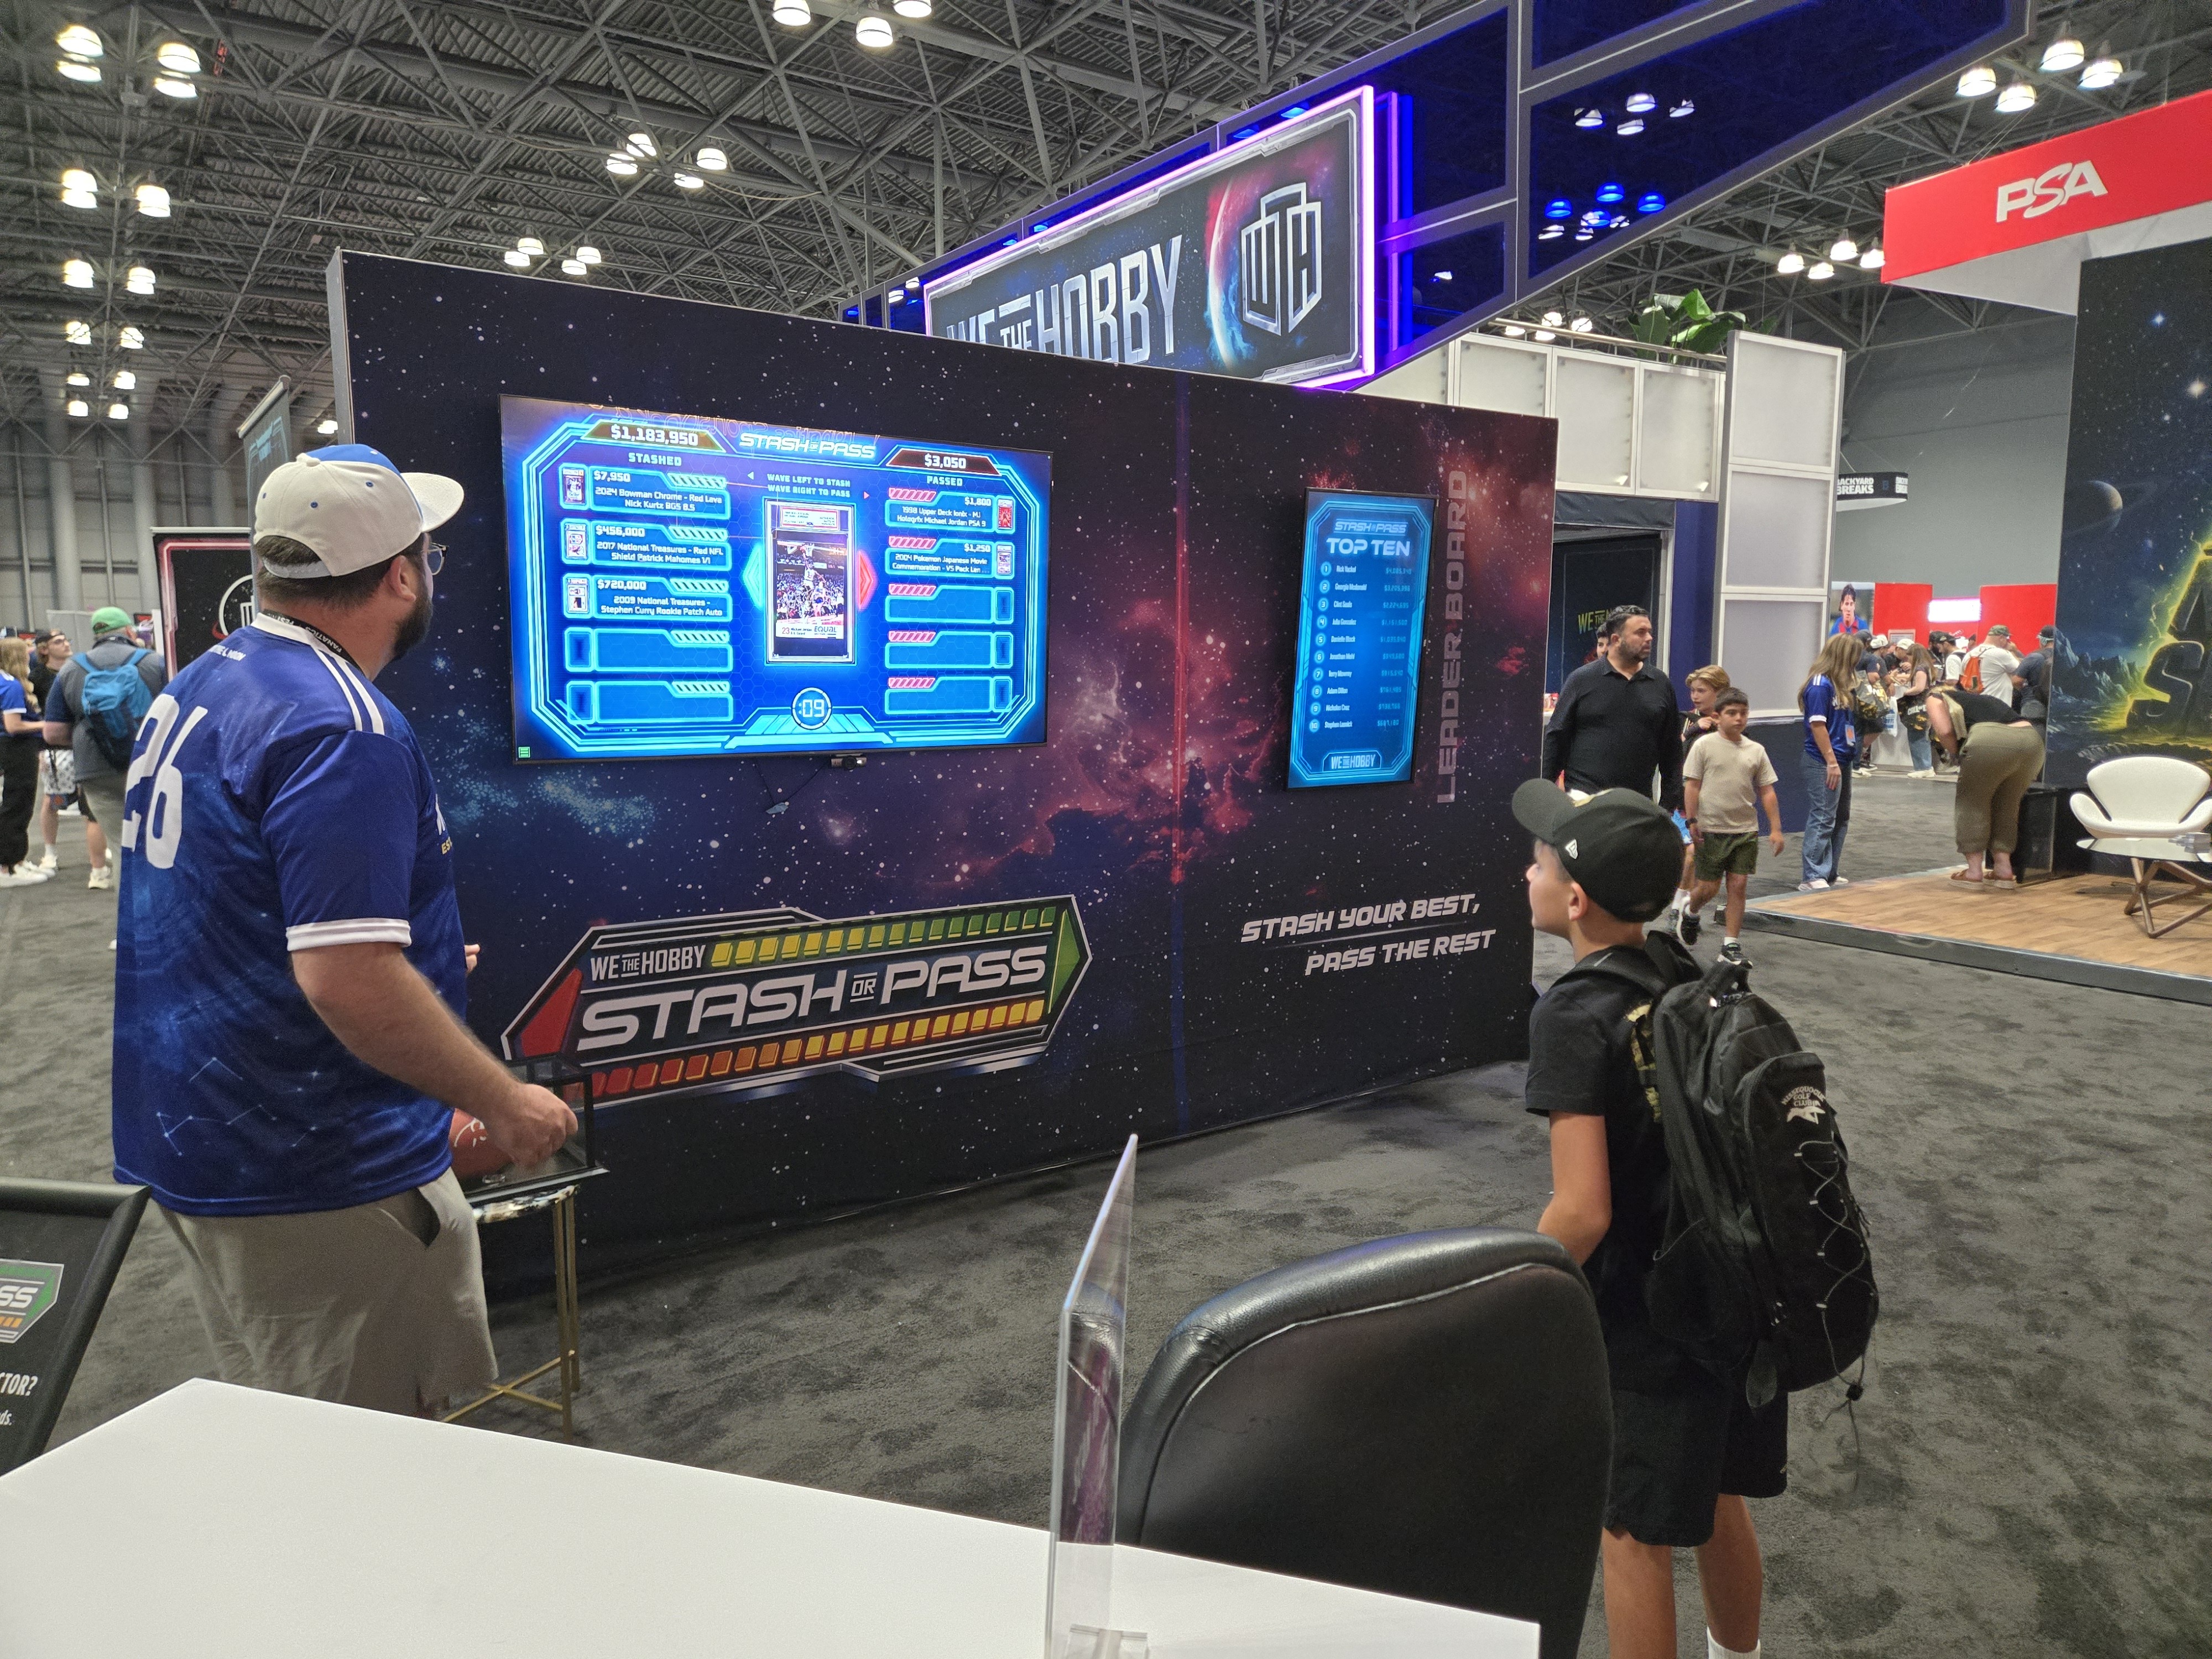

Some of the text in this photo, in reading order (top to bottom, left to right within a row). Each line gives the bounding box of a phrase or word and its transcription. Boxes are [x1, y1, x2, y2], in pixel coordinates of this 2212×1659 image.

[1996, 160, 2108, 222] PSA
[1036, 235, 1182, 364] HOBBY
[611, 424, 698, 446] $1,183,950
[739, 432, 810, 452] STASH
[819, 441, 876, 458] PASS
[628, 453, 682, 466] STASHED
[925, 454, 967, 471] $3,050
[594, 470, 630, 482] $7,950
[767, 473, 790, 482] WAVE
[792, 476, 812, 484] LEFT
[826, 479, 851, 487] STASH
[927, 476, 963, 487] PASSED
[595, 487, 617, 496] 2024
[619, 488, 653, 498] Bowman
[654, 492, 682, 500] Chrome
[706, 495, 722, 504] Lava
[768, 484, 791, 493] WAVE
[792, 487, 816, 495] RIGHT
[1837, 485, 1874, 495] BREAKS
[625, 499, 642, 508] Nick
[644, 500, 664, 509] Kurtz
[666, 502, 681, 510] BGS
[964, 497, 992, 507] $1,800
[919, 507, 936, 516] Upper
[924, 516, 947, 525] Michael
[1335, 521, 1371, 531] STASH
[1376, 524, 1407, 533] PASS
[596, 525, 645, 538] $456,000
[617, 543, 649, 552] National
[651, 544, 686, 553] Treasures
[964, 542, 990, 552] $1,250
[1326, 538, 1410, 556] TOP TEN
[612, 552, 635, 561] Shield
[638, 554, 664, 562] Patrick
[665, 555, 700, 564] Mahomes
[942, 556, 969, 565] Japanese
[893, 562, 941, 571] Commemoration
[597, 579, 646, 591] $720,000
[613, 596, 635, 604] 2009
[637, 597, 669, 606] National
[670, 598, 705, 606] Treasures
[601, 606, 633, 615] Stephen
[634, 607, 654, 615] Curry
[656, 607, 681, 615] Rookie
[683, 607, 703, 615] Patch
[1578, 612, 1594, 634] WE
[305, 626, 342, 653] FANATICS
[1437, 471, 1467, 803] LEADER BOARD
[1331, 757, 1343, 769] WE
[1350, 754, 1376, 768] HOBBY
[121, 693, 208, 869] 26
[1241, 894, 1480, 943] STASH YOUR BEST,
[1305, 929, 1496, 976] PASS THE REST
[590, 944, 706, 980] WE THE HOBBY
[577, 946, 1048, 1051] STASH OR PASS
